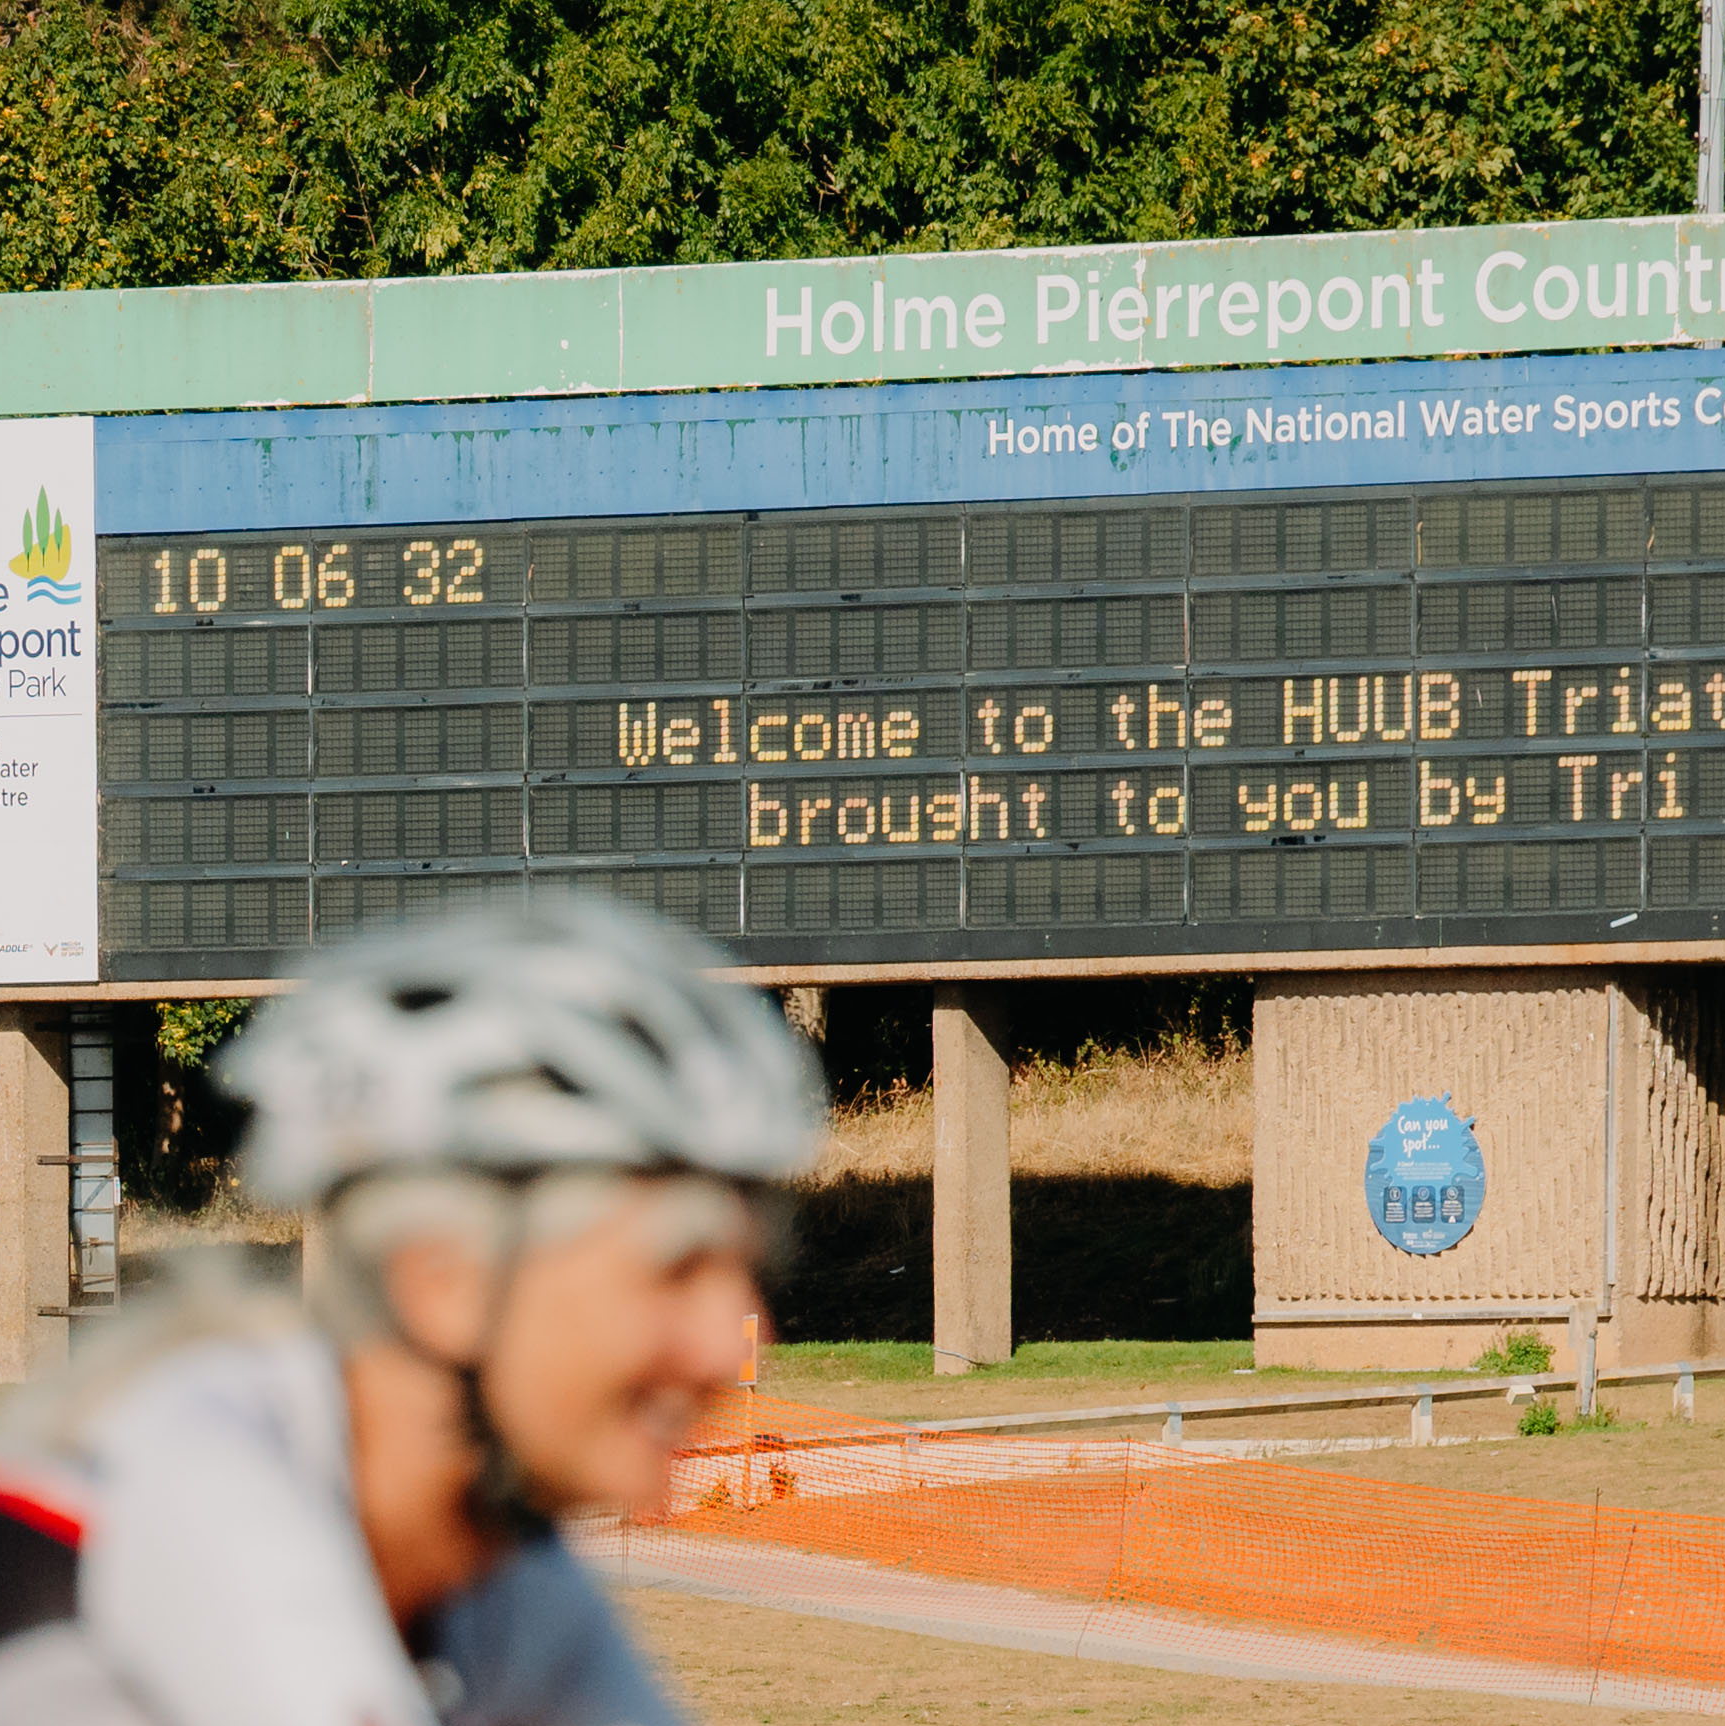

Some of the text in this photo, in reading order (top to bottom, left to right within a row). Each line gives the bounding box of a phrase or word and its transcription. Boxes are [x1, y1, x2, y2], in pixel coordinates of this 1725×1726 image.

[766, 280, 1005, 356] Holme
[1036, 258, 1444, 349] Pierrepont
[988, 418, 1099, 455] Home
[1111, 412, 1150, 451] of
[1162, 410, 1233, 448] The
[1245, 400, 1406, 444] National
[1419, 397, 1541, 437] Water
[1553, 391, 1681, 438] Sports
[156, 542, 483, 613] 10 06 32
[9, 667, 66, 698] Park
[620, 701, 920, 767] Welcome
[979, 701, 1054, 755] to
[1112, 688, 1233, 750] the
[1285, 675, 1461, 745] HUUB
[751, 777, 1046, 847] brought
[1113, 782, 1186, 836] to
[1239, 782, 1369, 832] you
[1421, 763, 1506, 826] by
[1559, 757, 1684, 822] Tri
[1398, 1115, 1449, 1137] Can you
